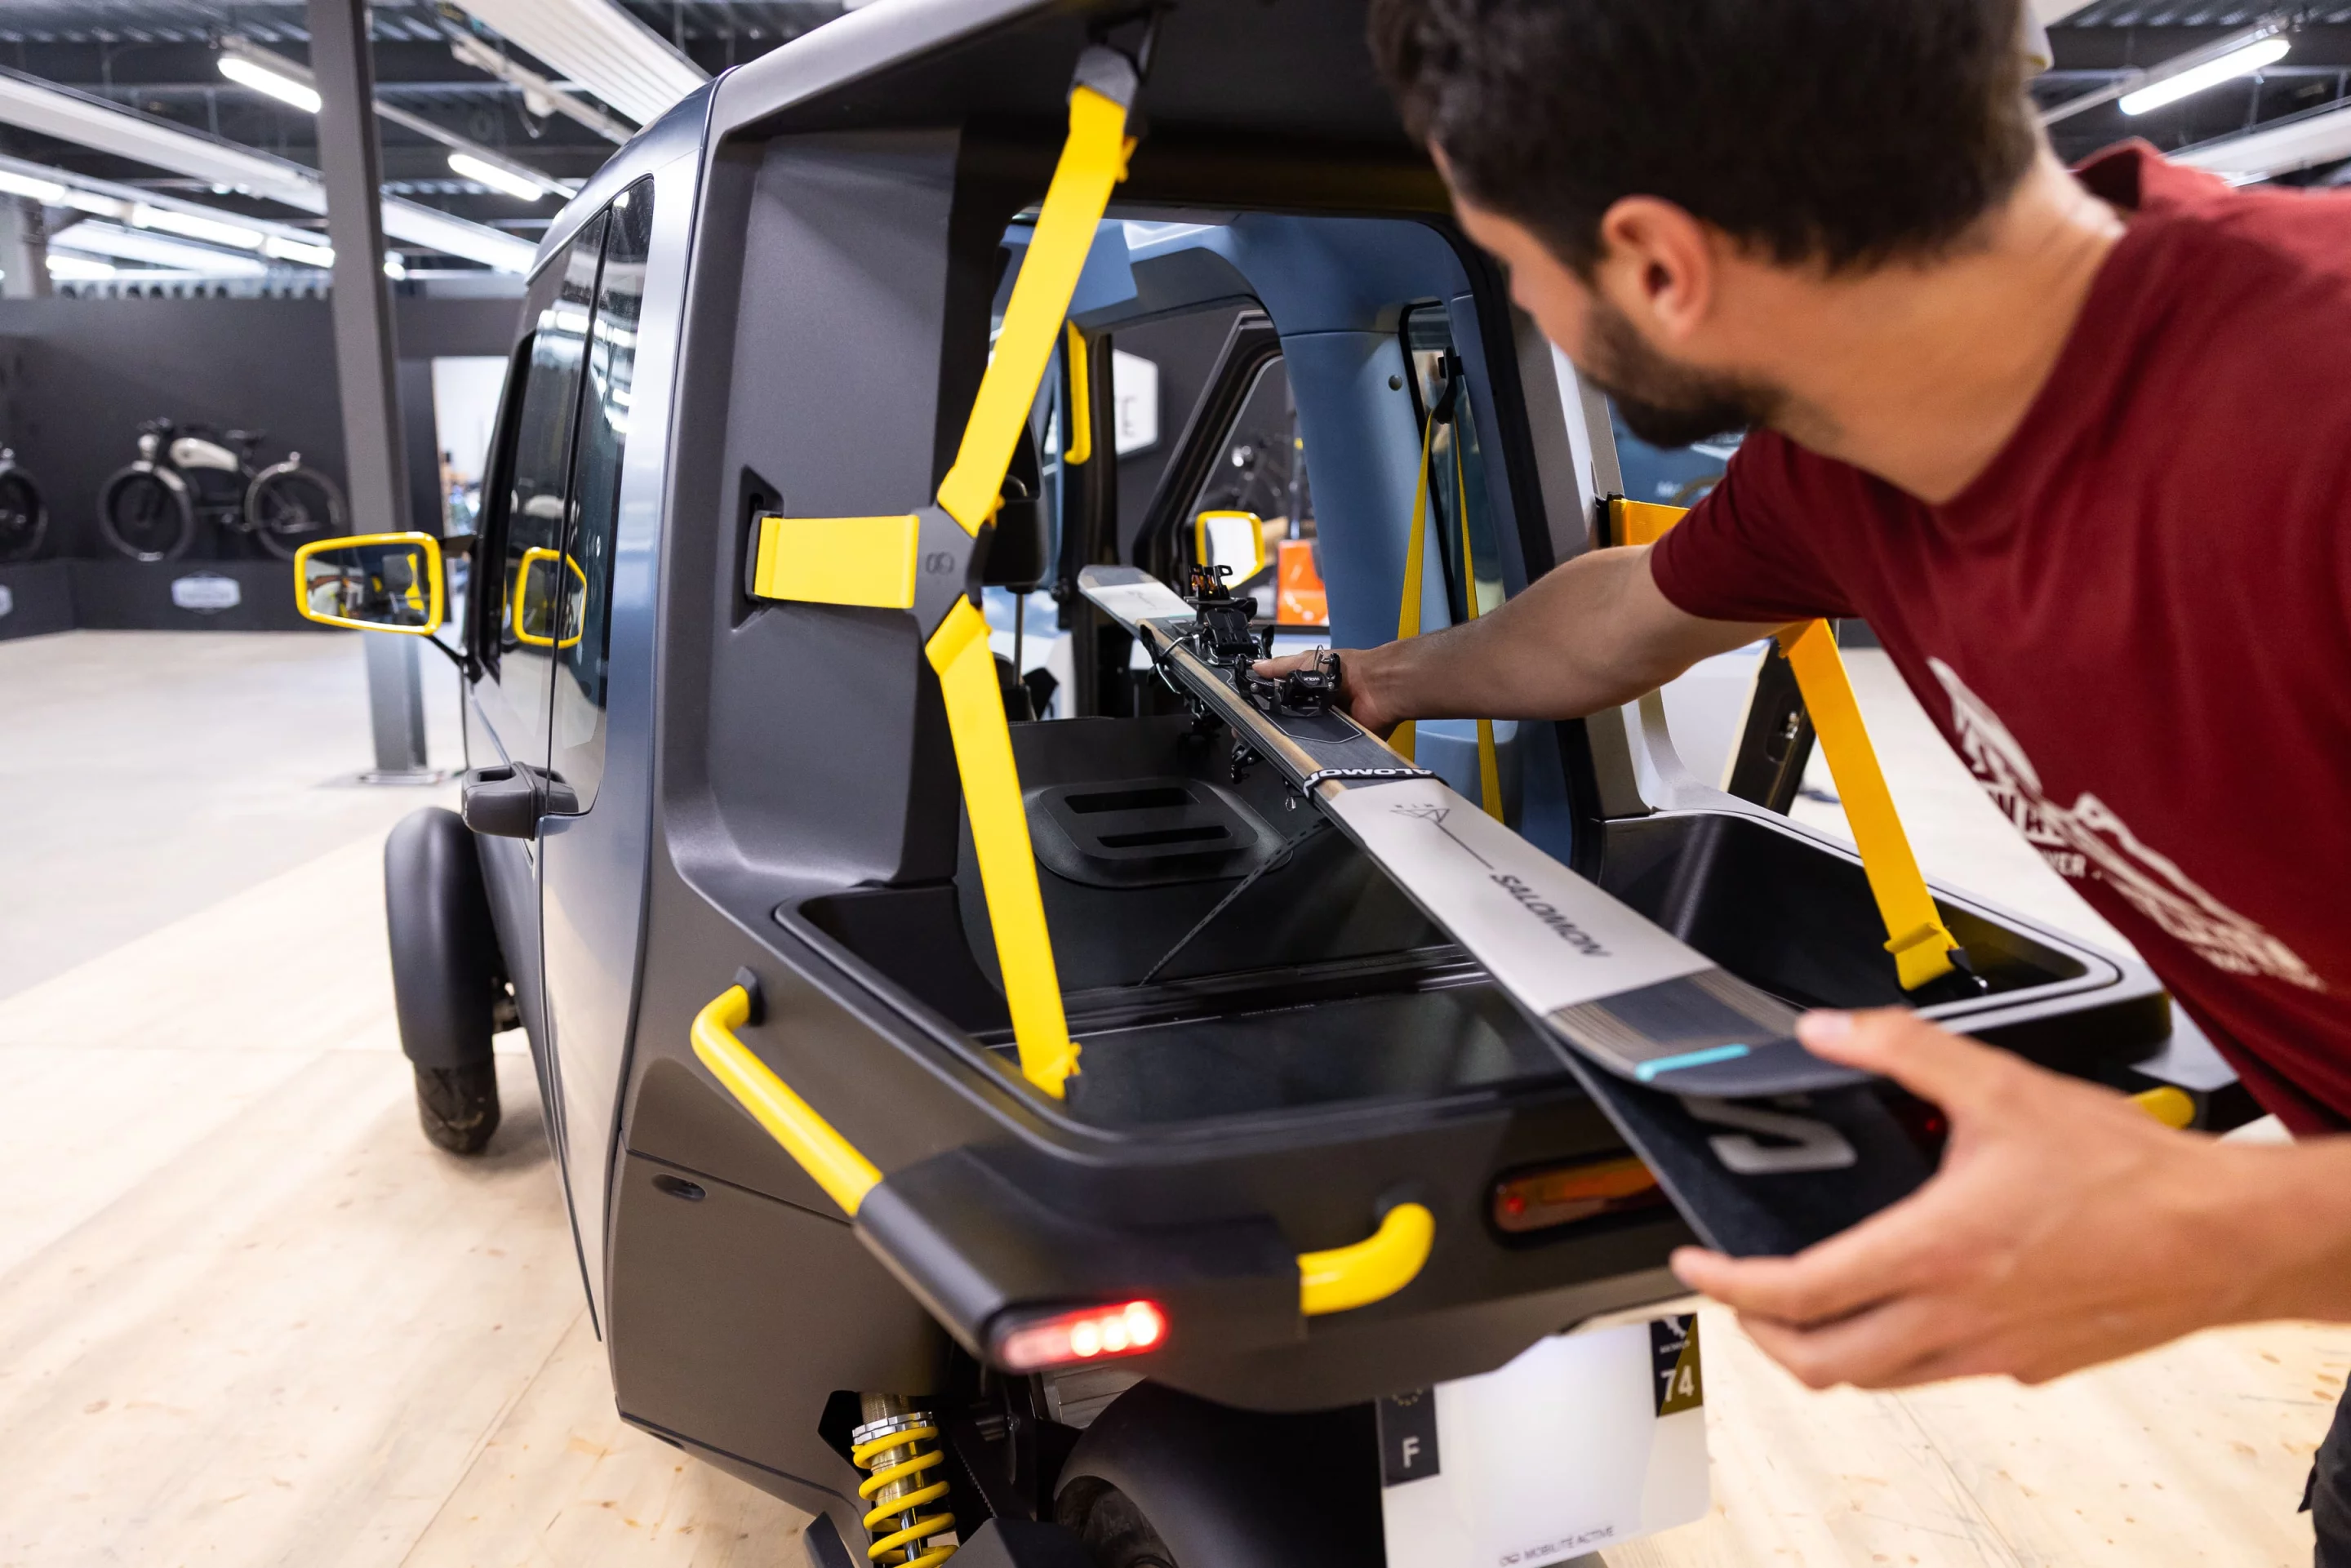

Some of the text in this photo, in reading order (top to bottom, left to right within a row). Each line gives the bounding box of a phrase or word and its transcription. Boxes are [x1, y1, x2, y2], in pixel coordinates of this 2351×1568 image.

[1490, 874, 1613, 957] SALOMON
[1660, 1364, 1695, 1402] 74
[1403, 1436, 1420, 1468] F
